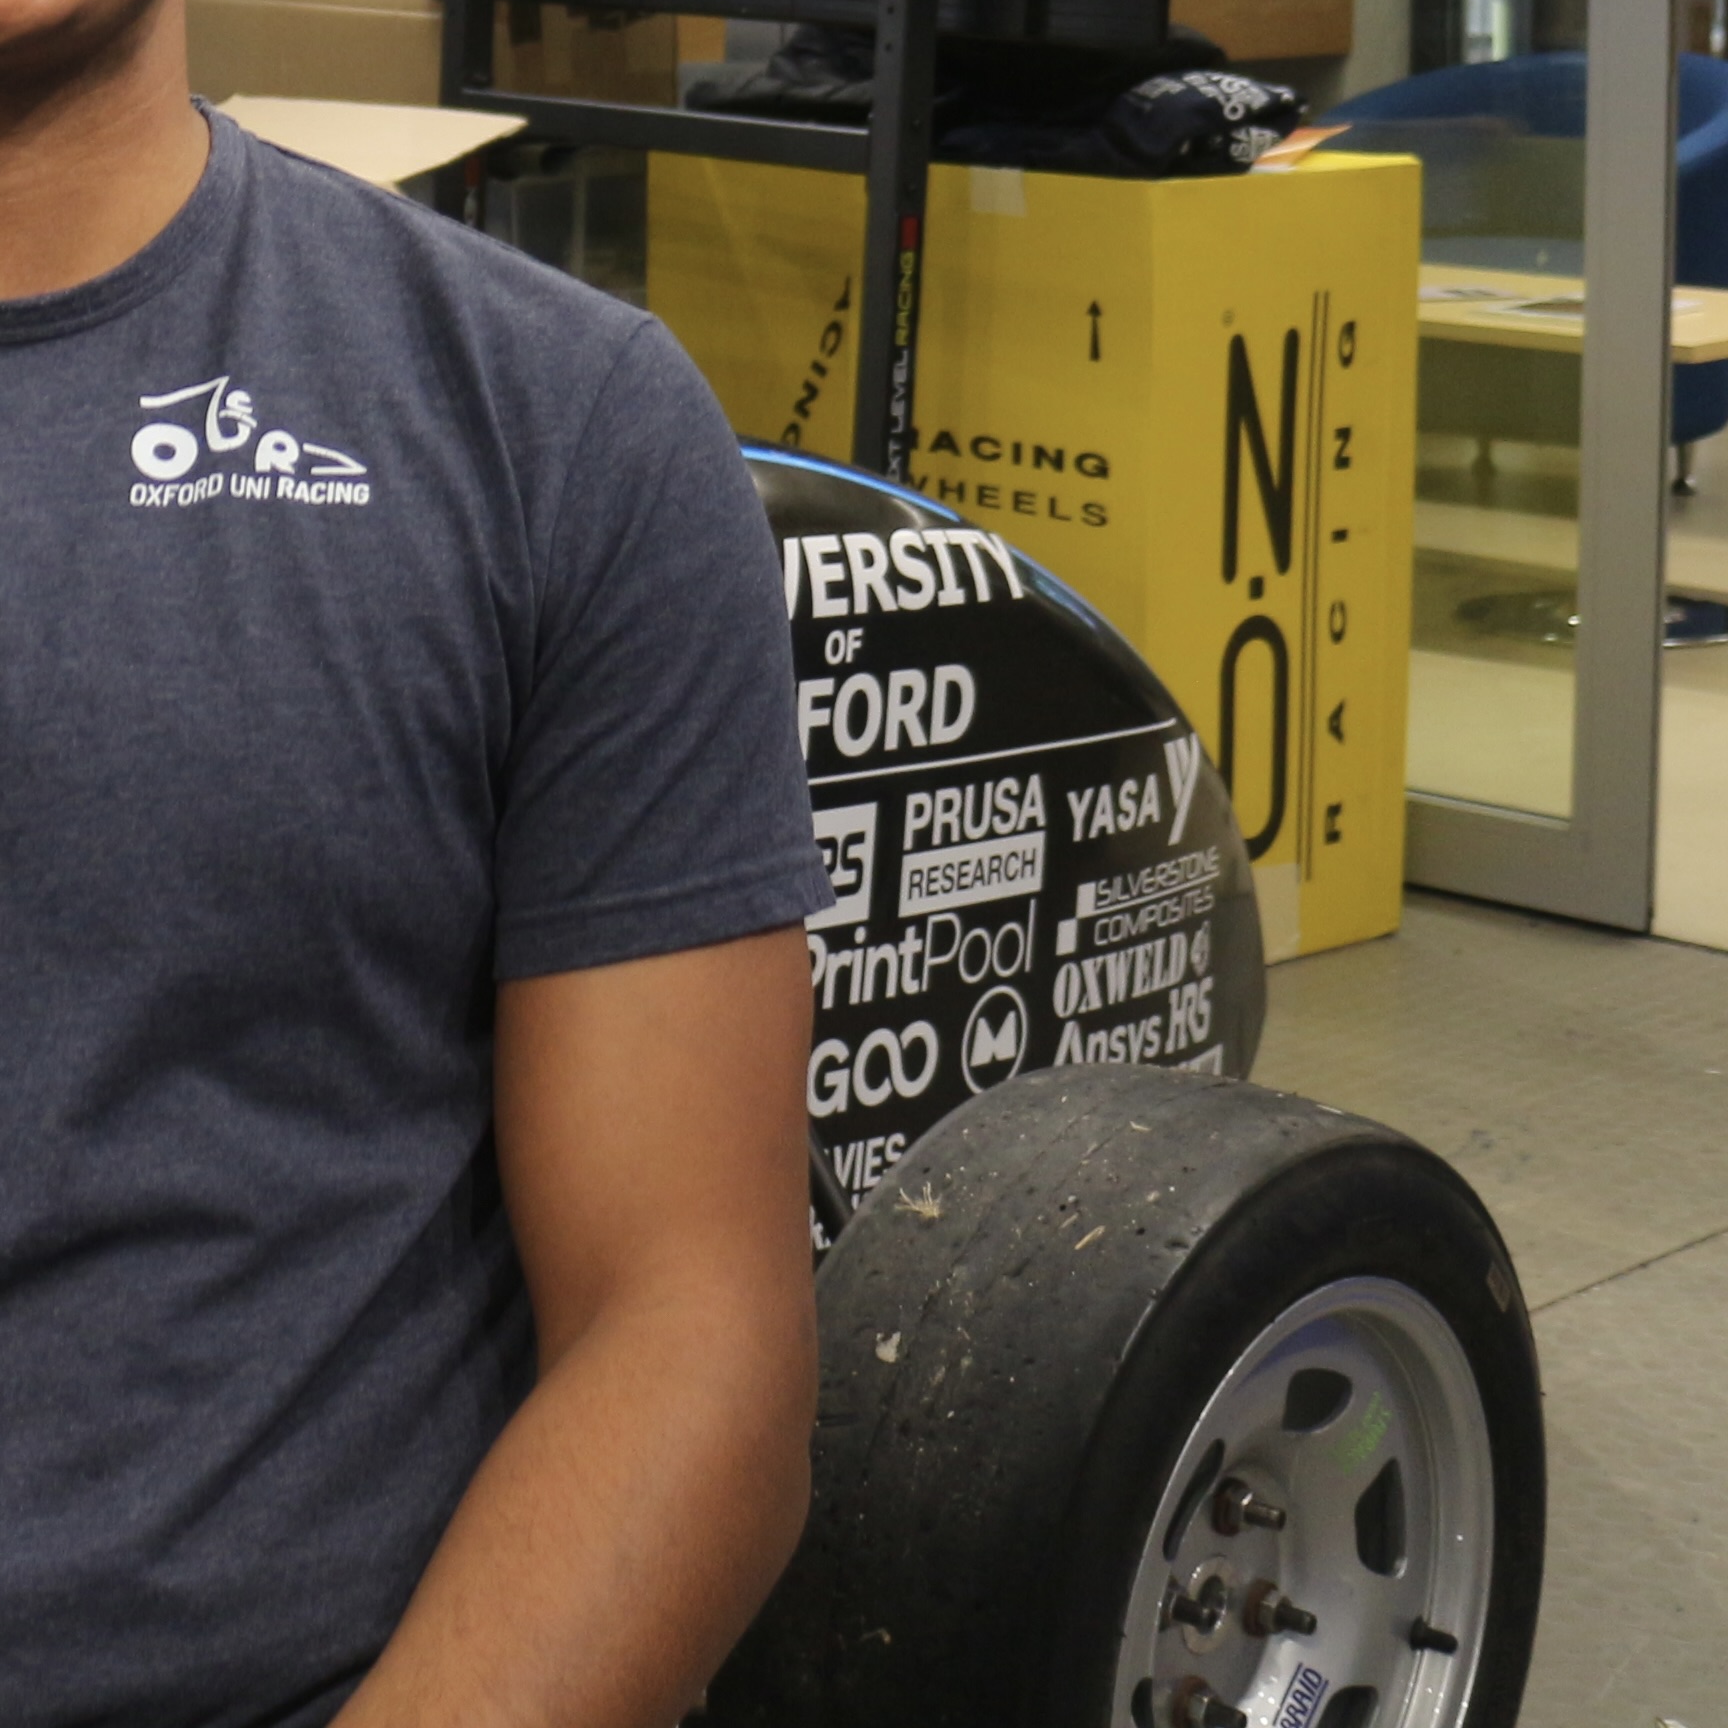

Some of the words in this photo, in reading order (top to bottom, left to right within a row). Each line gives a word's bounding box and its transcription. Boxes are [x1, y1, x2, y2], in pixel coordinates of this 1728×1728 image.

[895, 251, 916, 347] RACING
[890, 349, 909, 433] LEVEL
[130, 473, 223, 507] OXFORD
[230, 473, 270, 500] UNI
[276, 475, 370, 505] RACING
[825, 628, 863, 665] OF
[798, 664, 975, 760] FORD
[903, 774, 1046, 851] PRUSA
[1067, 774, 1161, 842] YASA
[907, 848, 1037, 901] RESEARCH
[1095, 845, 1220, 907] SILVERSTONE
[1093, 885, 1215, 946] COMPOSITES
[1053, 932, 1188, 1019] OXWELD
[1052, 1015, 1162, 1068] Ansys
[824, 1132, 906, 1189] VIES
